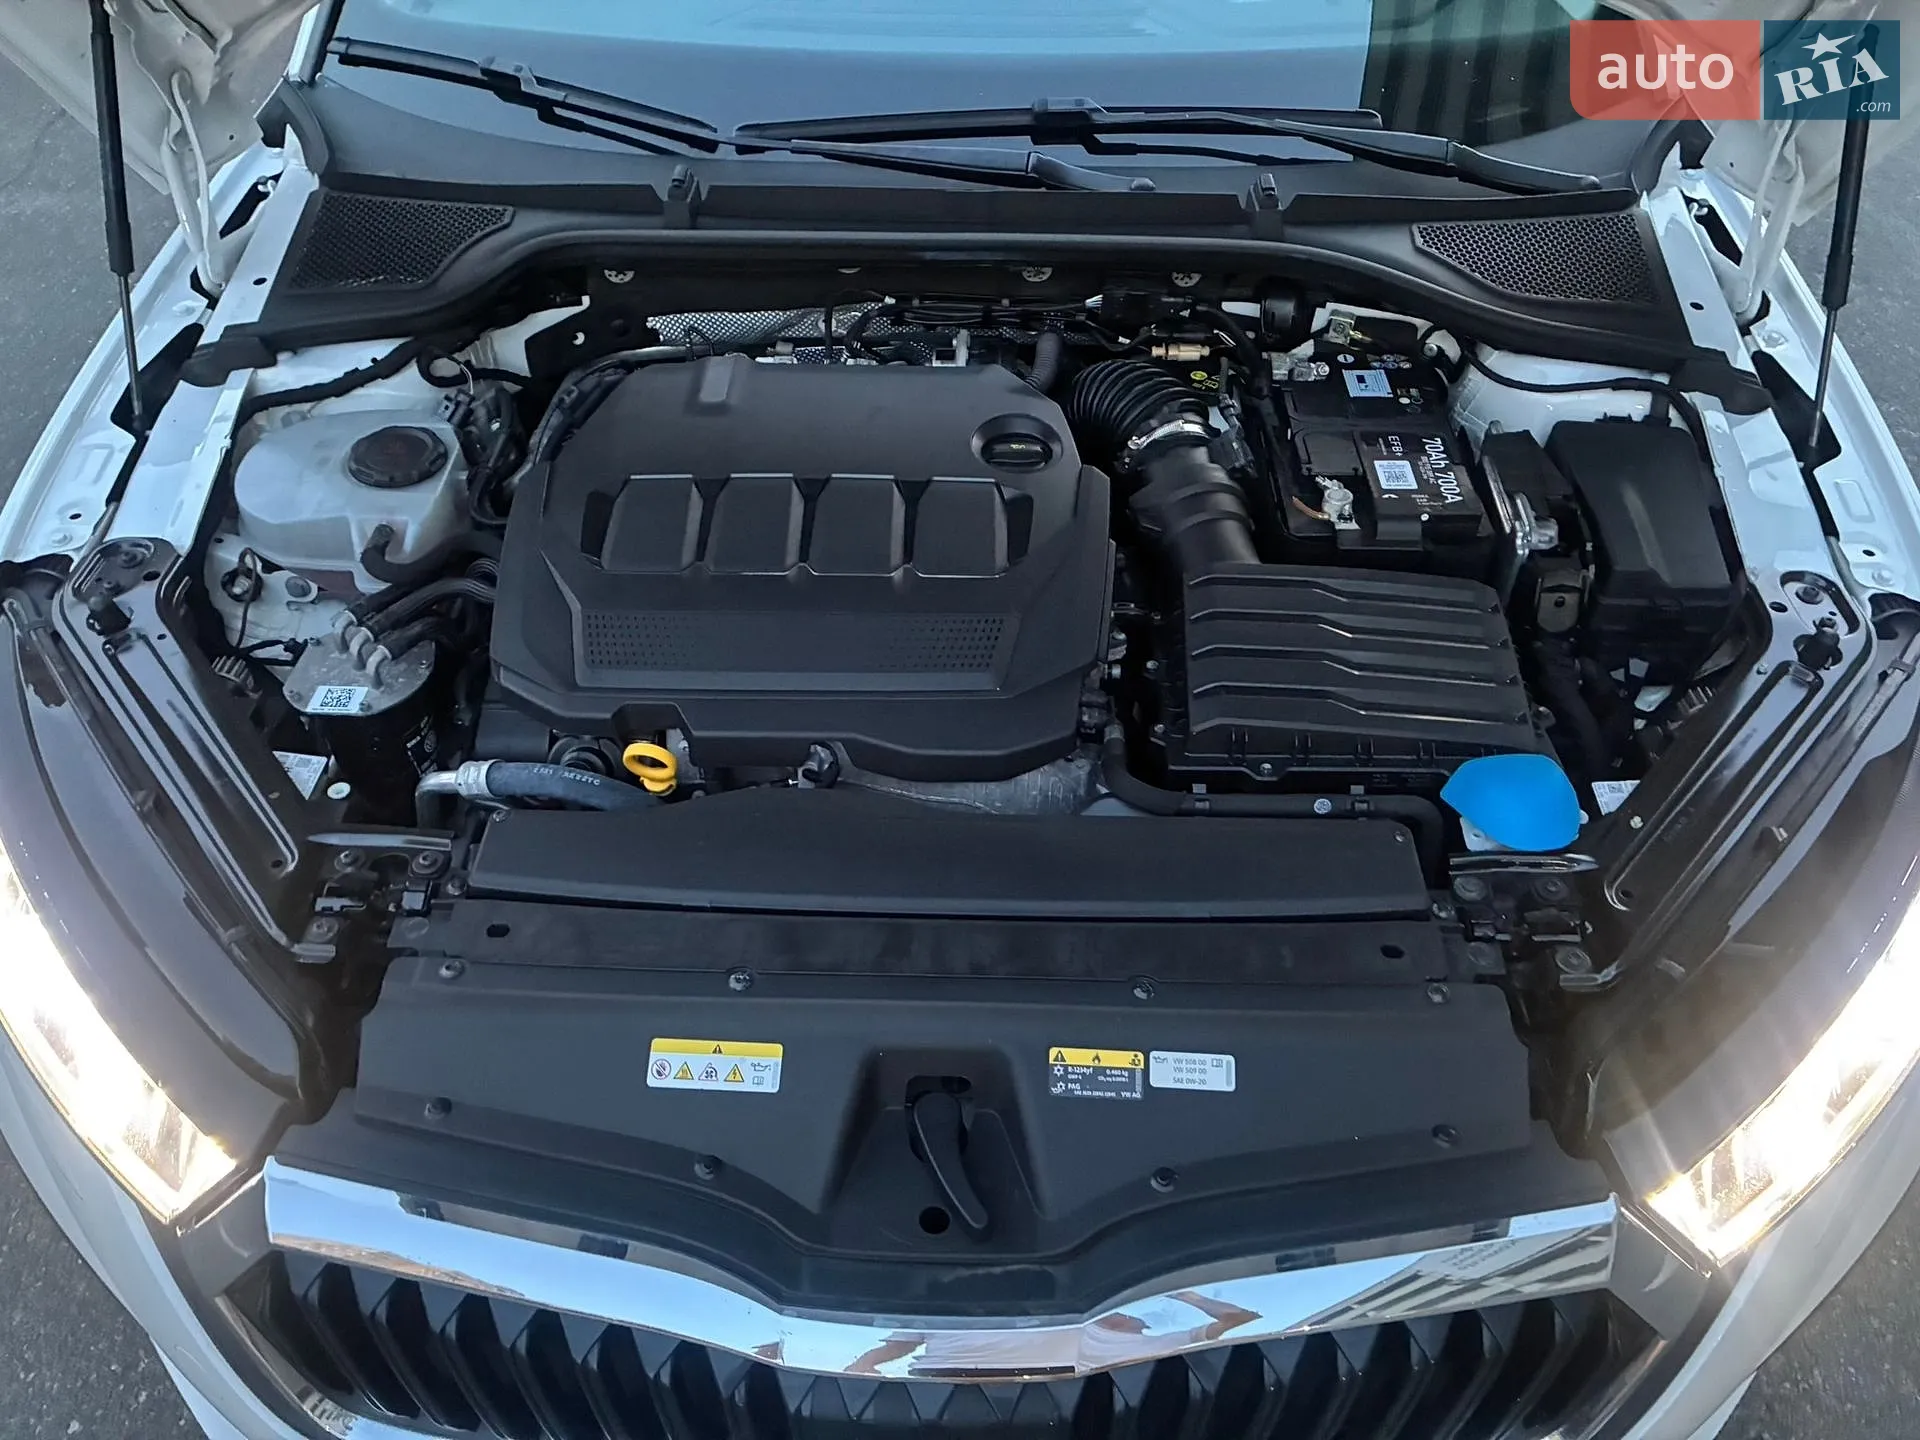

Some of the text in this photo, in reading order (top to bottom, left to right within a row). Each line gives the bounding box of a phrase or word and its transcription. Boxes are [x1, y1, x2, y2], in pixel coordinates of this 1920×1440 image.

[1421, 437, 1450, 468] 70Ah
[1434, 471, 1464, 503] 700A
[1198, 1067, 1207, 1075] 00
